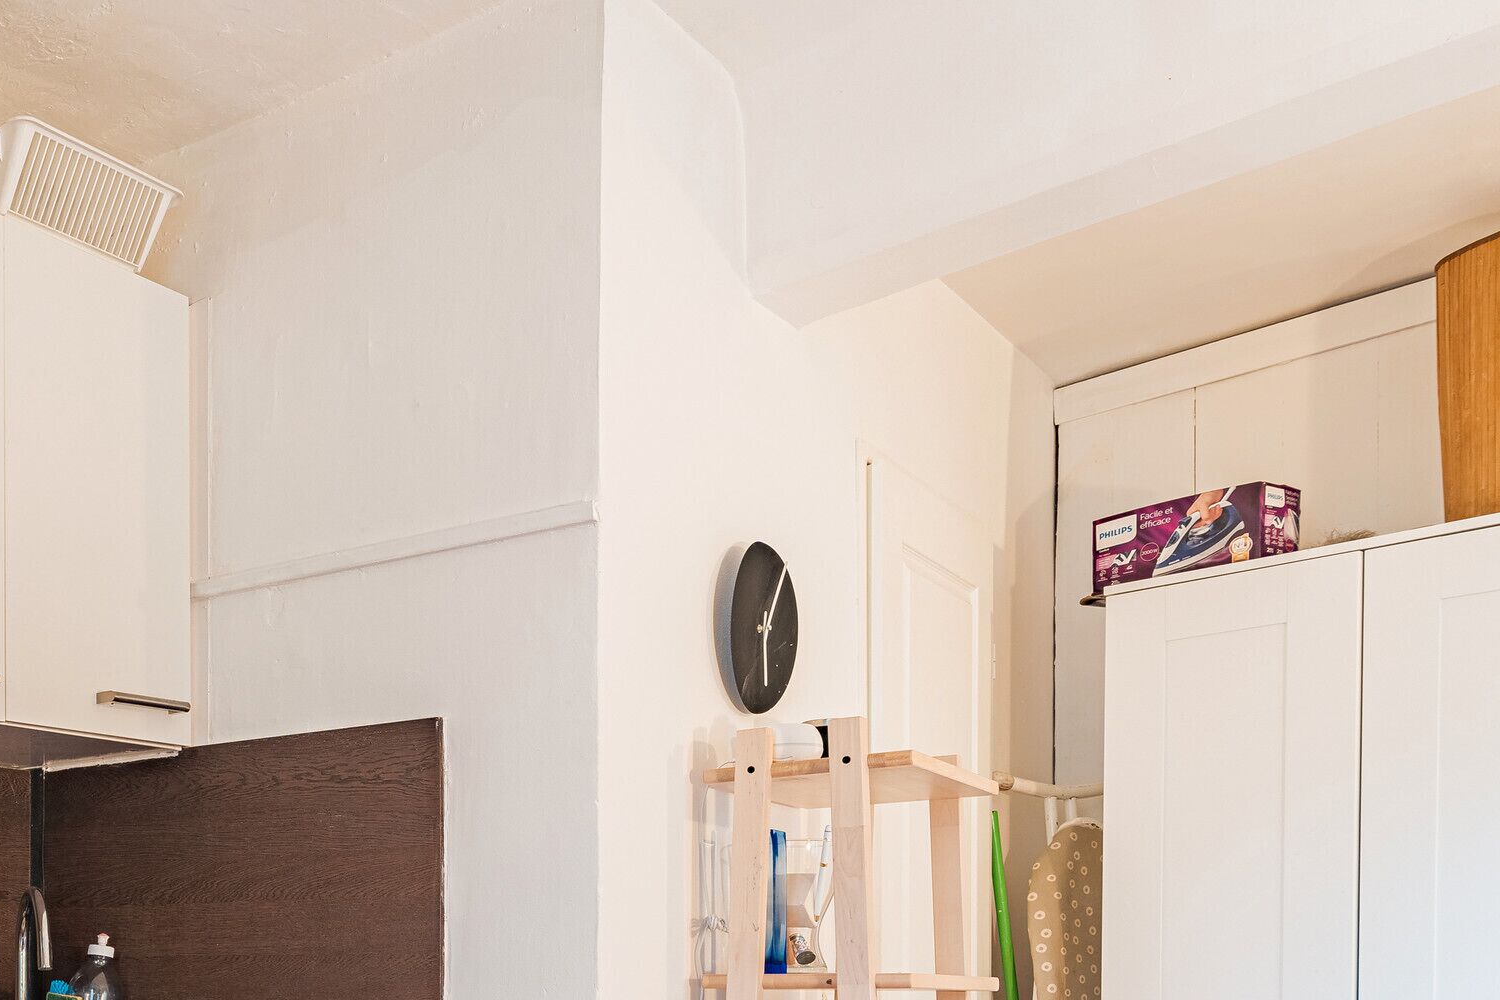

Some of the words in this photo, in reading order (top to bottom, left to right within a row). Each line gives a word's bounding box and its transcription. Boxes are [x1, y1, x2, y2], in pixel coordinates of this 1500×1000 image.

[1140, 510, 1164, 520] Facile
[1164, 507, 1174, 515] et
[1140, 517, 1172, 530] efficace
[1099, 525, 1133, 540] PHILIPS
